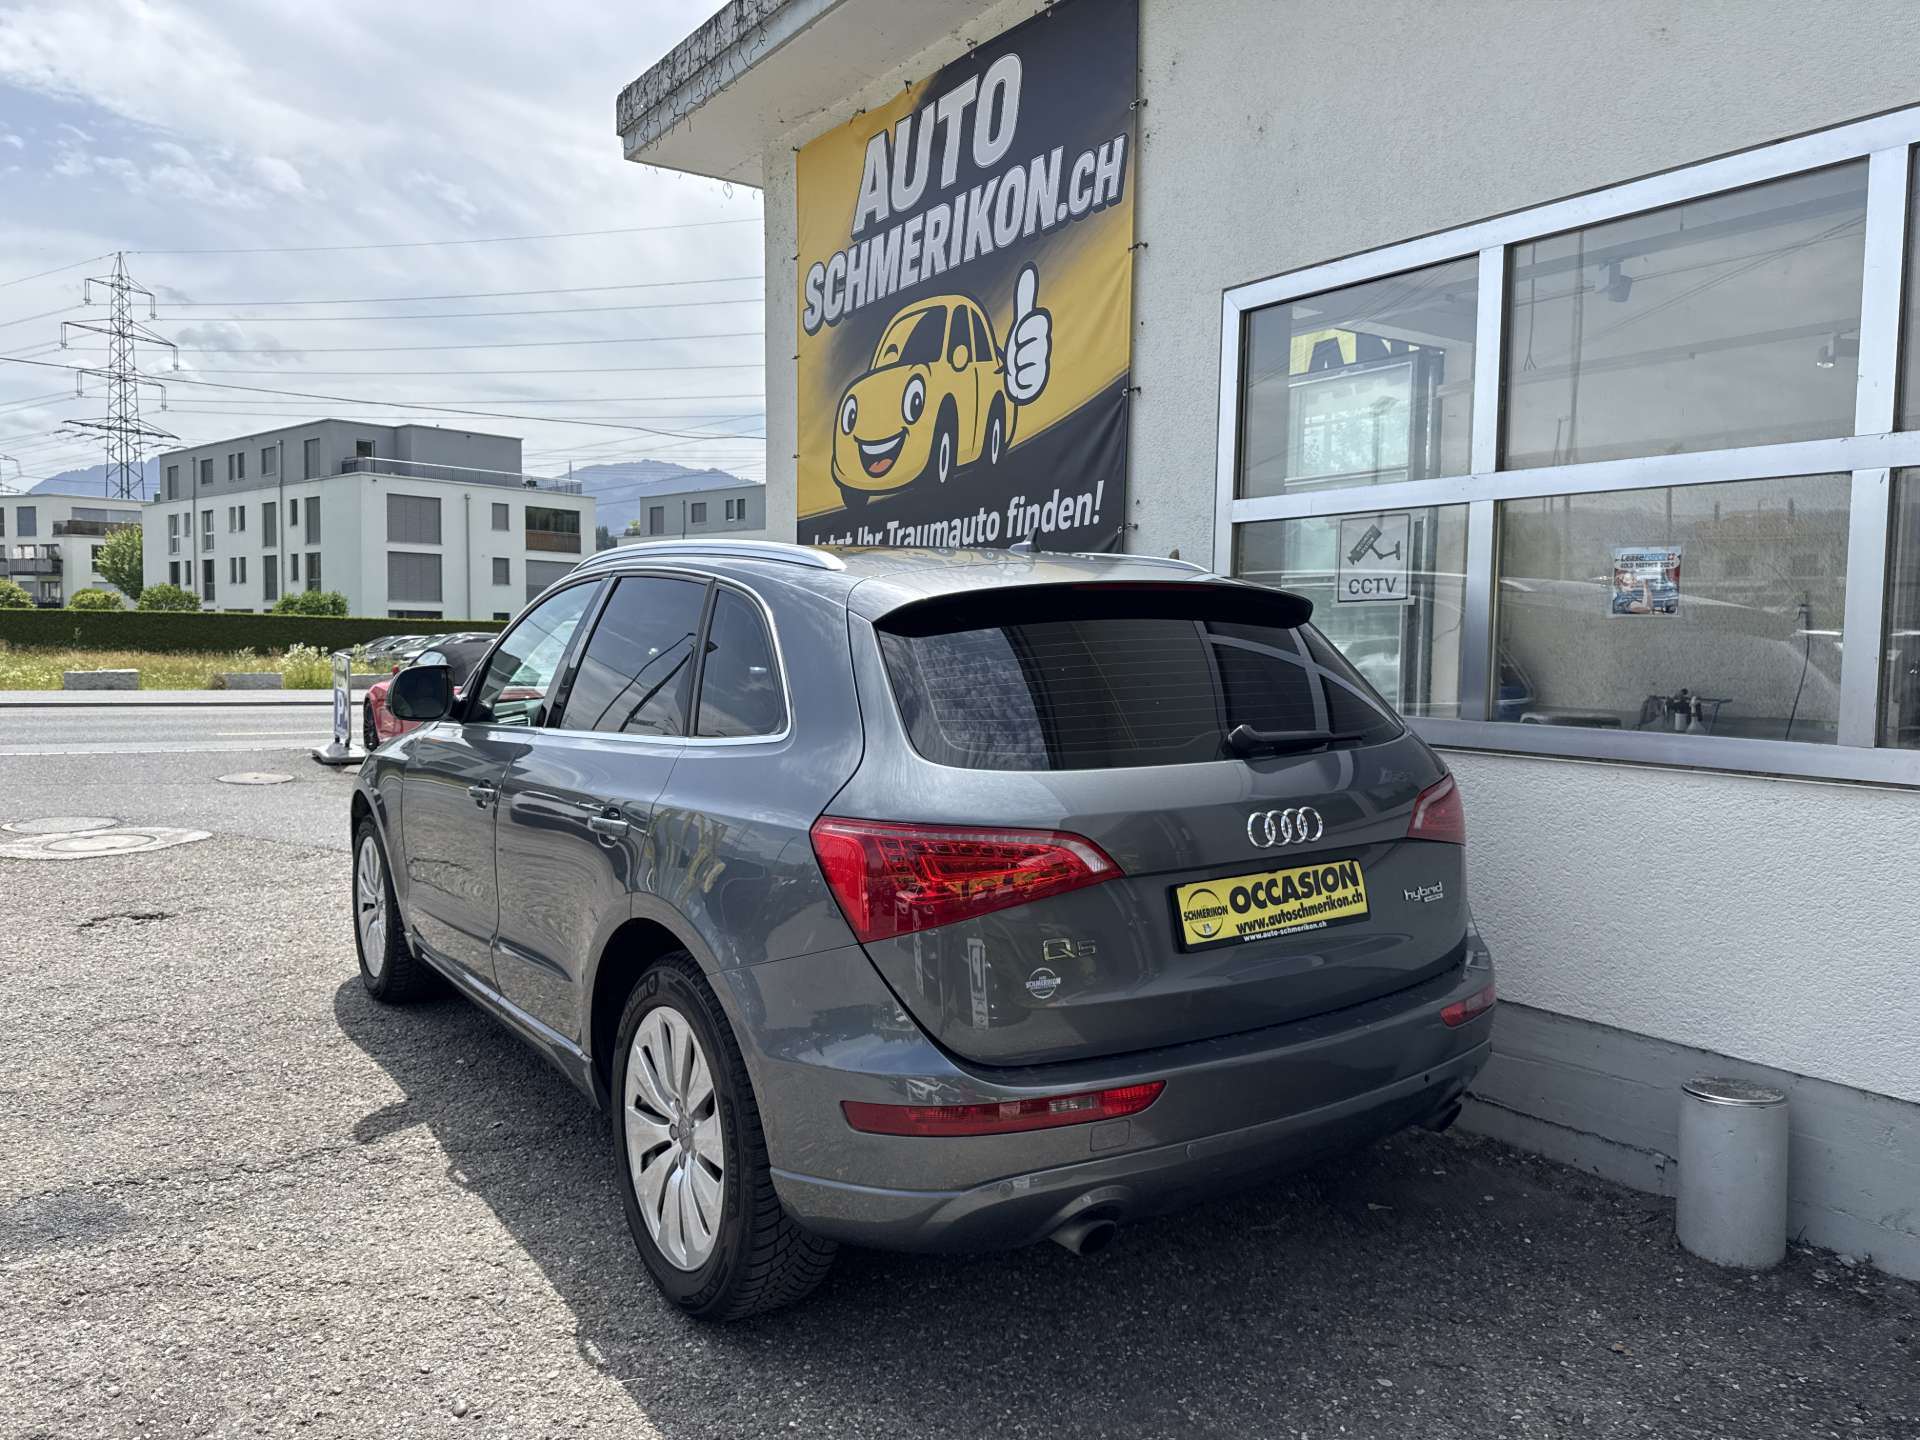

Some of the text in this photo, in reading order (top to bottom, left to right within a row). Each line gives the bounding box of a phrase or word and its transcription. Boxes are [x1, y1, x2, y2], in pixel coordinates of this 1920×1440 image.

[852, 53, 1022, 236] AUTO
[803, 134, 1128, 333] SCHMERIKON.CH
[857, 525, 883, 546] Ihr
[886, 507, 1001, 547] Traumauto
[1006, 480, 1105, 538] finden!
[1348, 576, 1398, 596] CCTV
[1229, 862, 1360, 914] OCCASION
[1403, 880, 1444, 902] hybrid
[1183, 904, 1229, 922] SCHMERIKON
[1235, 889, 1364, 935] www.autoschmerikon.ch
[1243, 920, 1328, 942] www.auto-schmerikon.ch
[1043, 938, 1096, 960] Q5
